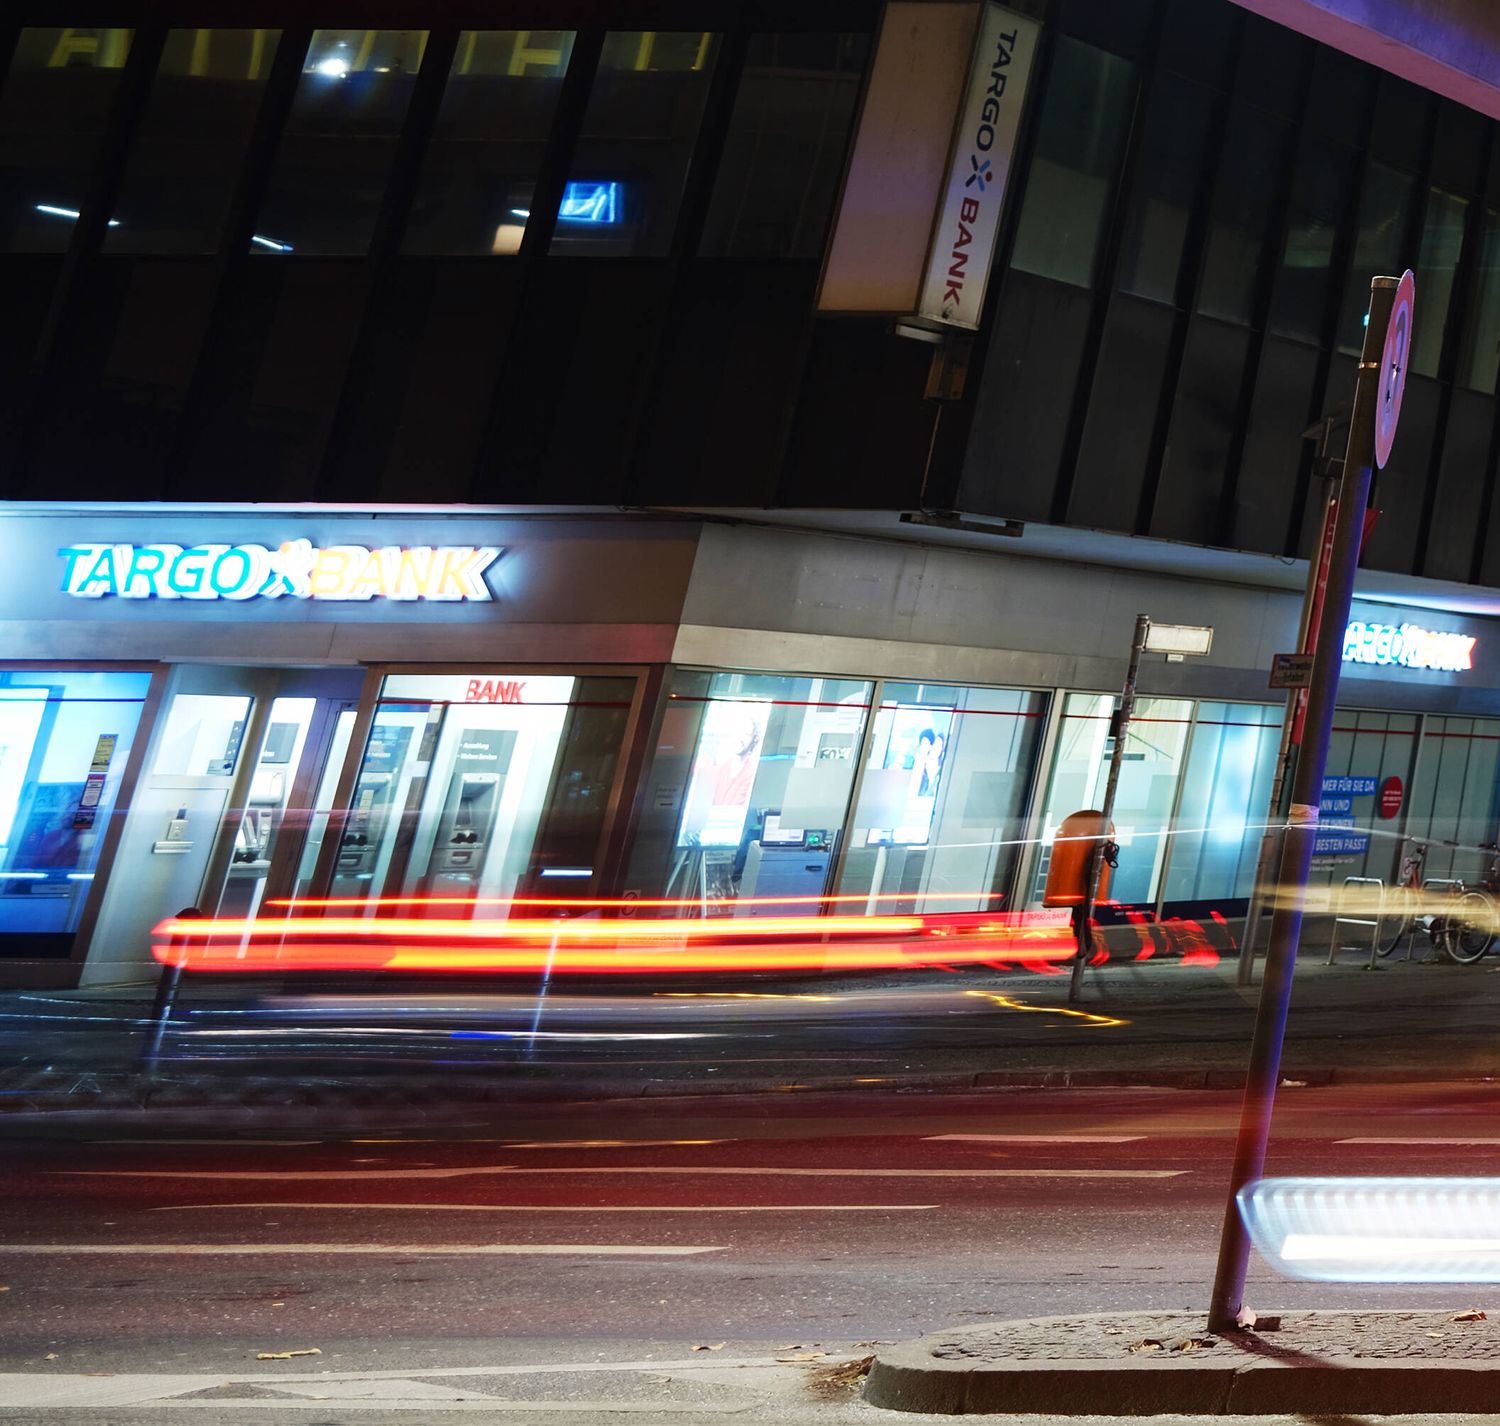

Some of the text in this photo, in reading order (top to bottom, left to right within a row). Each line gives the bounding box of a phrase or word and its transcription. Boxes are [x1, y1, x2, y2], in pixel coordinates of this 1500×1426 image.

[942, 29, 1017, 306] TARGO BANK
[58, 544, 503, 601] TARGO BANK
[1341, 621, 1404, 665] ARGO
[464, 678, 528, 704] BANK
[1322, 780, 1338, 792] MER
